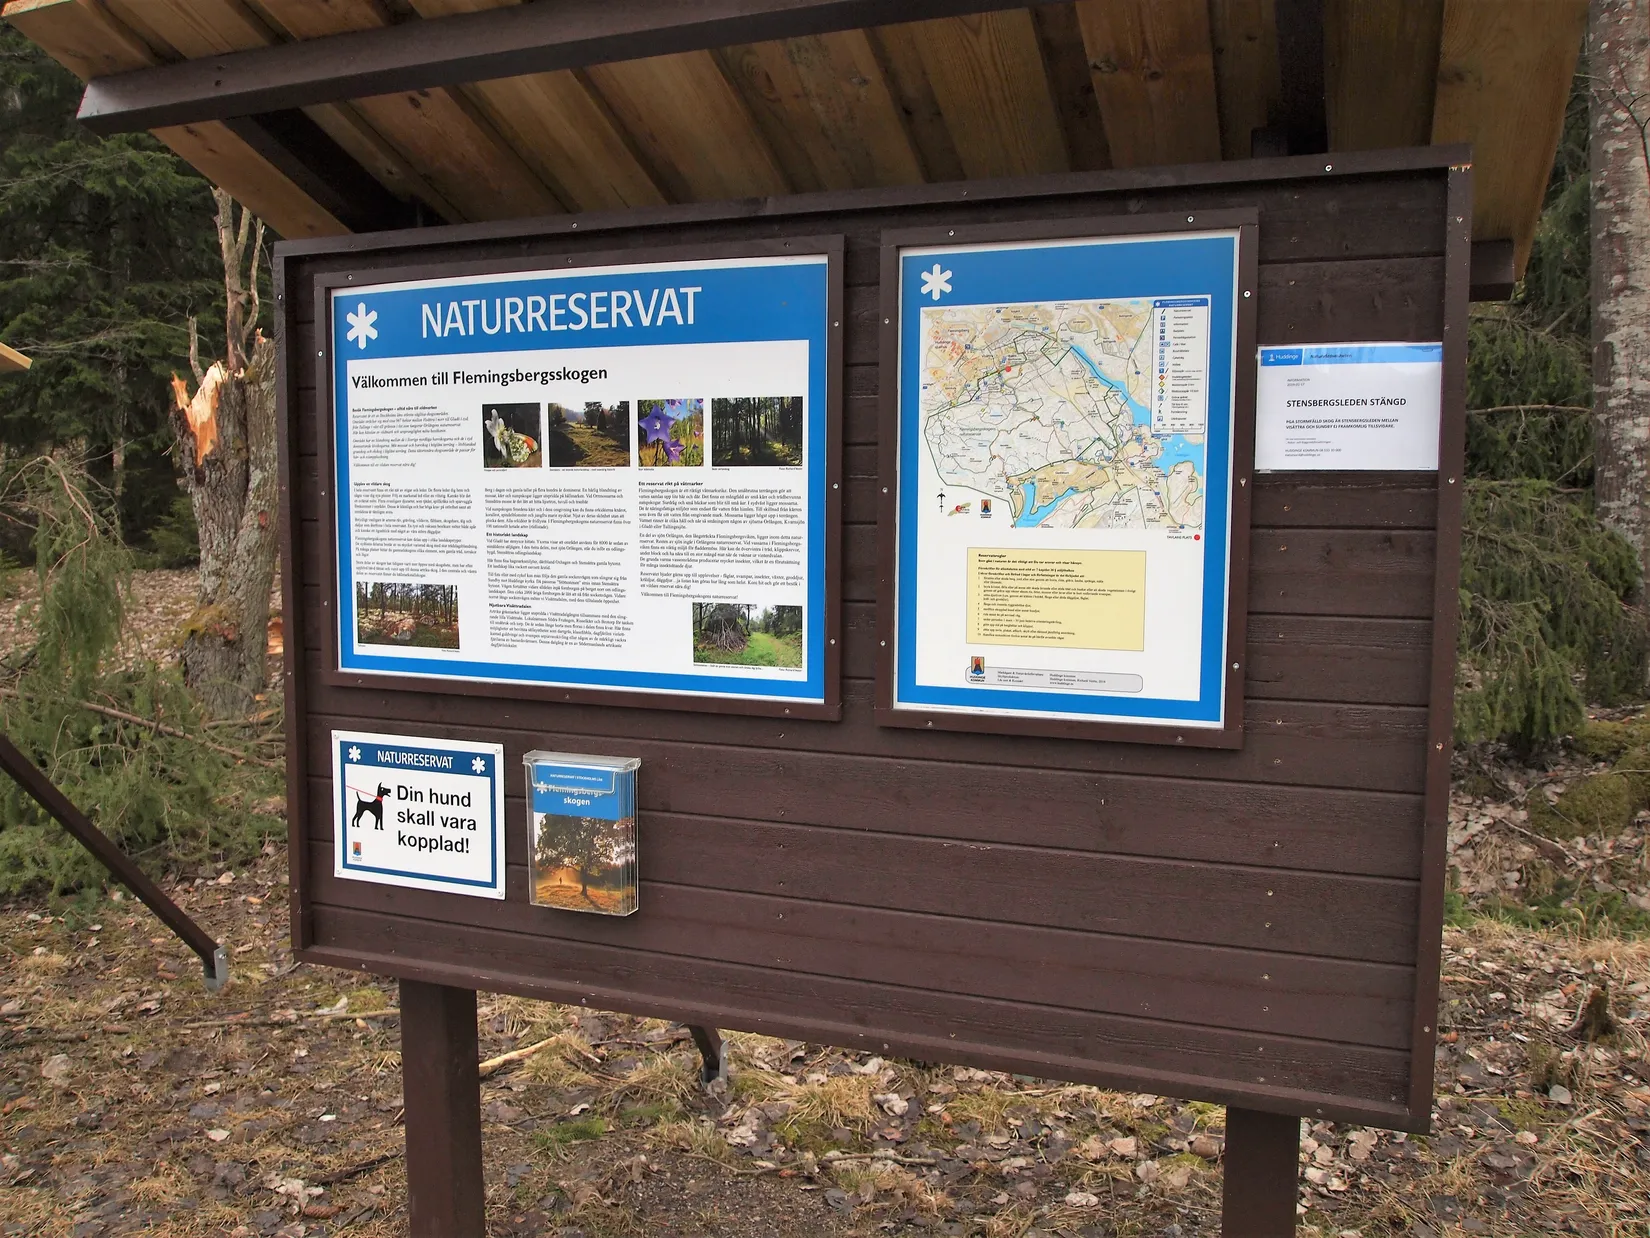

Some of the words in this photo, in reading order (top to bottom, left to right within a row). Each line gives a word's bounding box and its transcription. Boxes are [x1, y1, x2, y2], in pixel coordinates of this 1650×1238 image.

[421, 286, 702, 338] NATURRESERVAT
[352, 374, 427, 389] Välkommen
[432, 372, 448, 385] till
[453, 367, 608, 387] Flemingsbergsskogen
[1287, 399, 1367, 407] STENSBERGSLEDEN
[1370, 396, 1406, 406] STÄNGD
[377, 750, 453, 769] NATURRESERVAT
[397, 785, 423, 802] Din
[429, 788, 471, 807] hund
[564, 796, 590, 806] skogen
[397, 808, 435, 826] skall
[440, 816, 476, 831] vara
[398, 831, 470, 854] kopplad!
